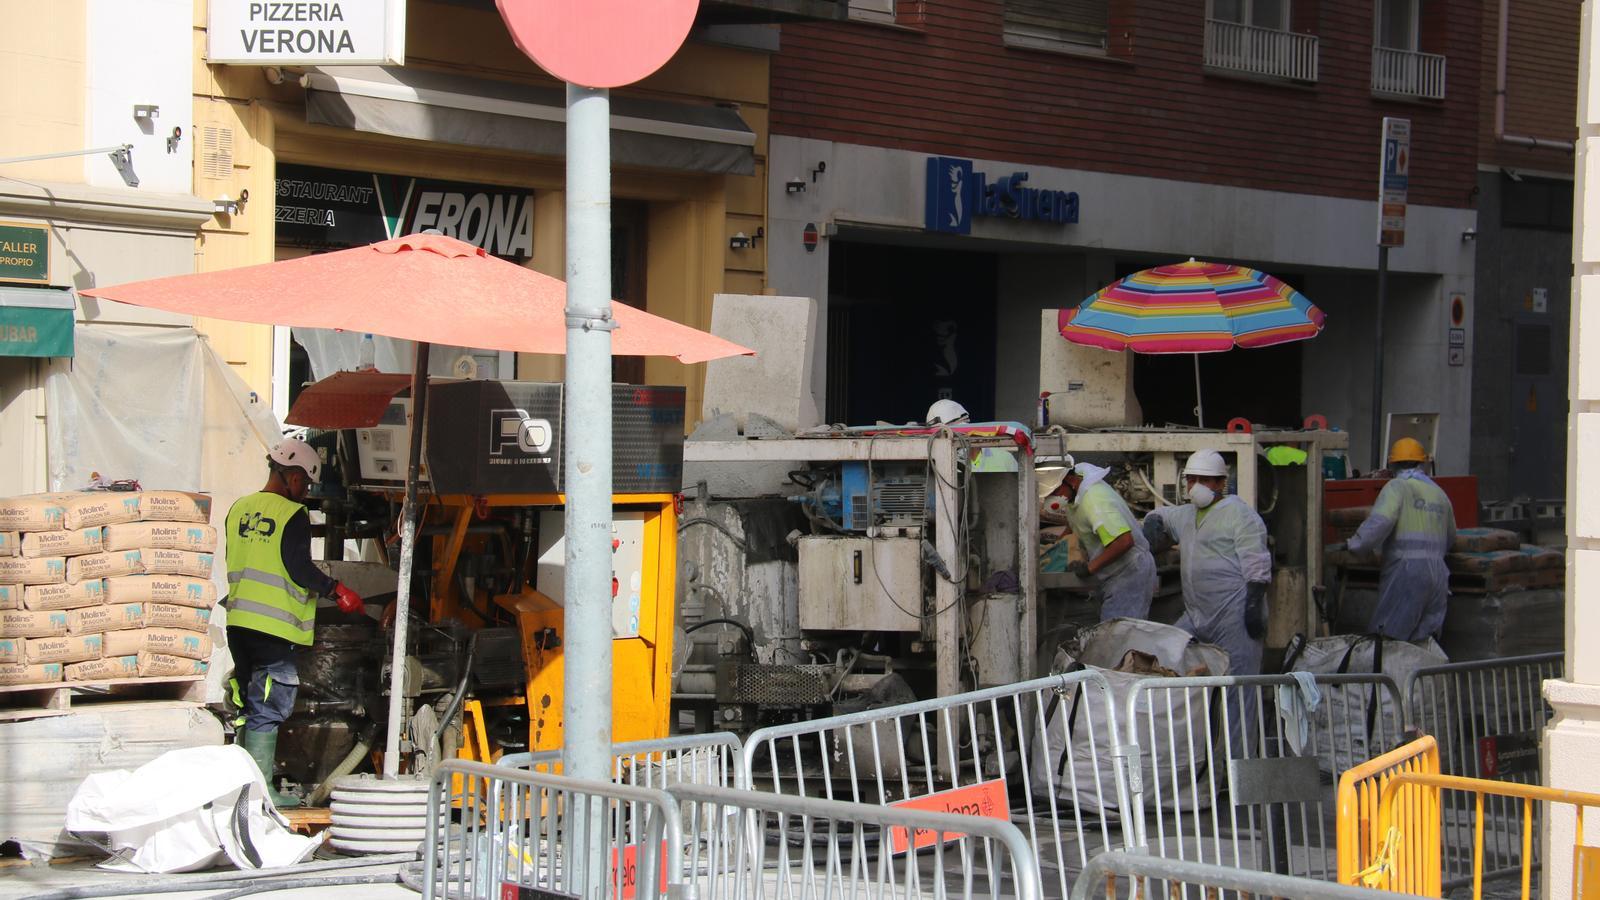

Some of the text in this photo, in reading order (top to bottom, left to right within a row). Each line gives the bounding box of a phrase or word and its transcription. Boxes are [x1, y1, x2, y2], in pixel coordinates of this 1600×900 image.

[250, 3, 344, 21] PIZZERIA
[240, 29, 355, 54] VERONA
[275, 178, 373, 204] ESTAURANT
[275, 205, 335, 227] ZZERIA
[0, 241, 37, 254] ALLER
[150, 497, 176, 505] Molins
[78, 505, 105, 515] Molins
[151, 528, 178, 536] Molins
[39, 535, 65, 543] Molins
[154, 551, 180, 559] Molins
[0, 561, 26, 569] Molins
[80, 559, 106, 567] Molins
[39, 588, 66, 596] Molins
[152, 604, 178, 613] Molins
[80, 610, 106, 620] Molins
[148, 634, 174, 642] Molins
[38, 642, 65, 650] Molins
[151, 654, 176, 664] Molins
[0, 666, 25, 674] Molins
[78, 662, 104, 672] Molins
